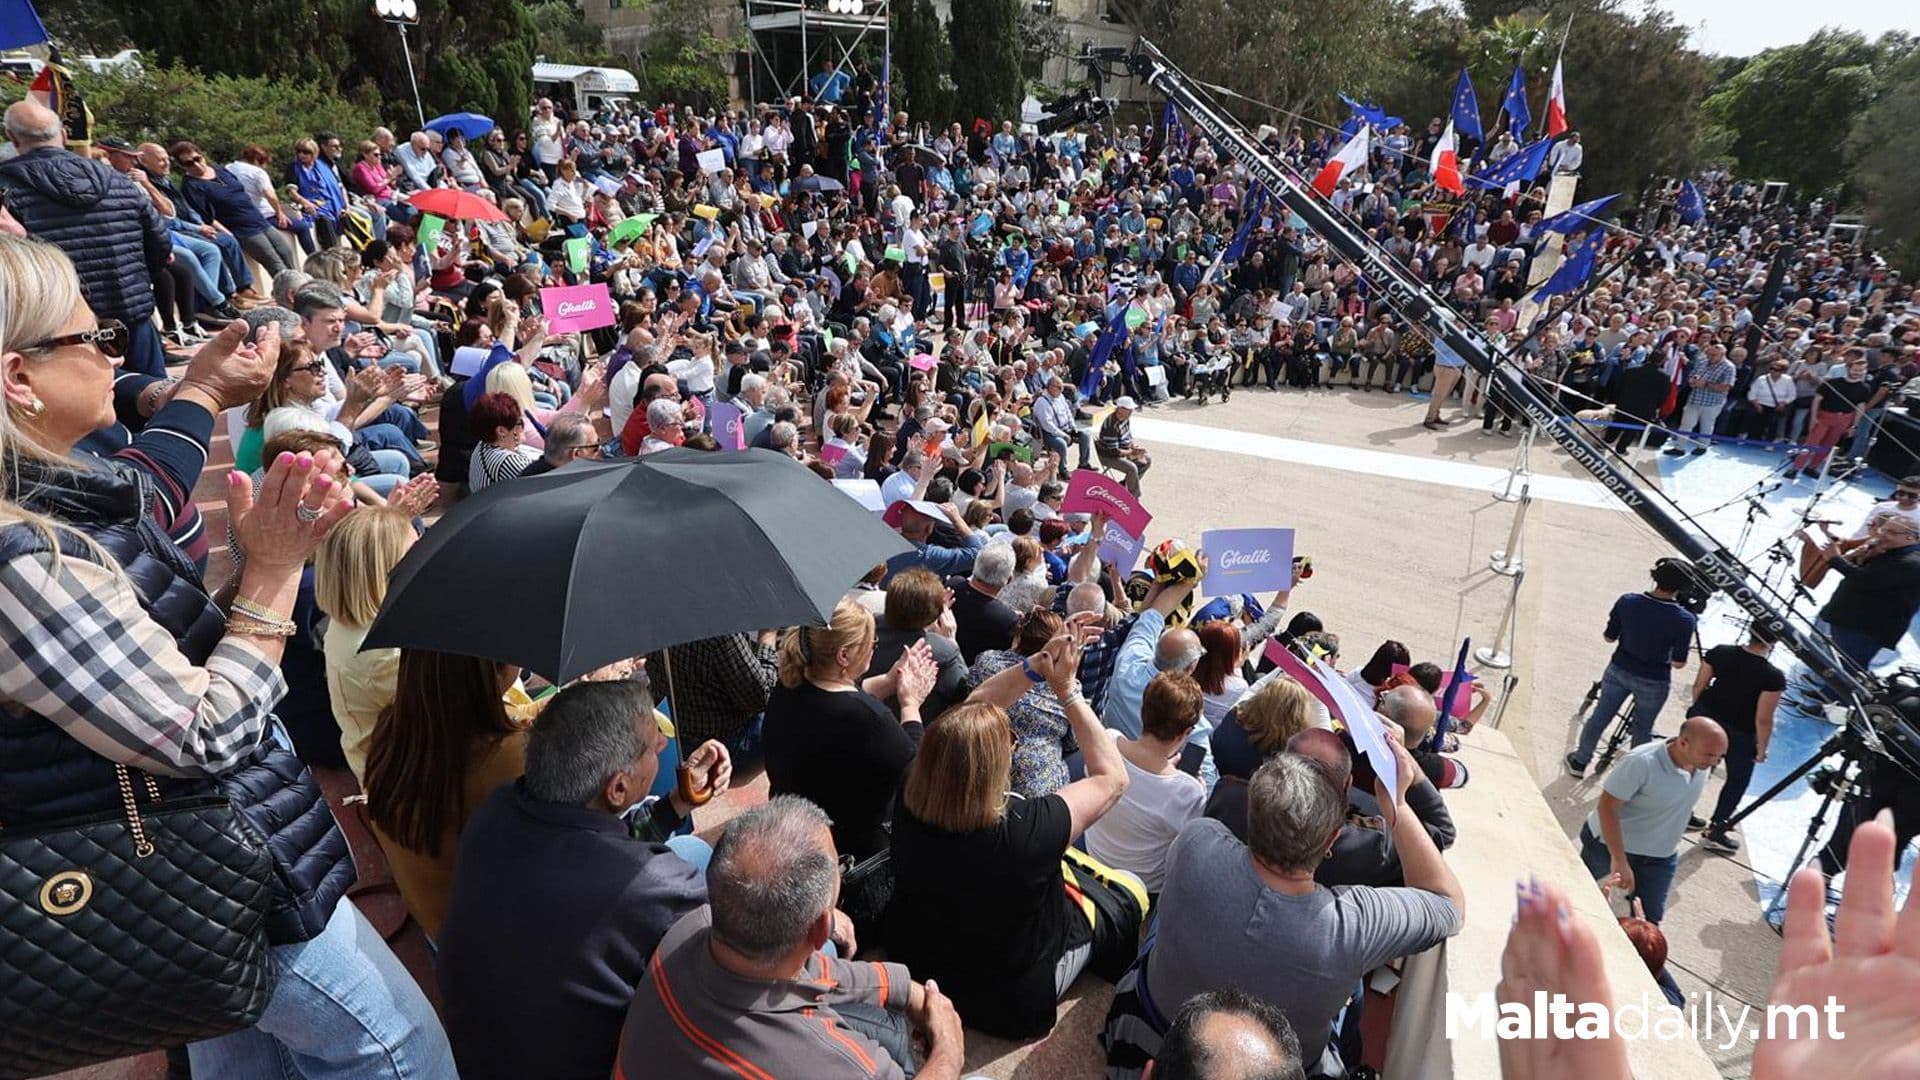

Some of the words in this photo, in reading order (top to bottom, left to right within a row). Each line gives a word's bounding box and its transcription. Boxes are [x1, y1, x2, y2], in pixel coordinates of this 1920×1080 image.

[1189, 104, 1290, 197] wwwpanther.tv
[1525, 402, 1644, 506] www.panther.tv
[1220, 548, 1271, 569] Ghalik
[1695, 552, 1736, 586] Pixy
